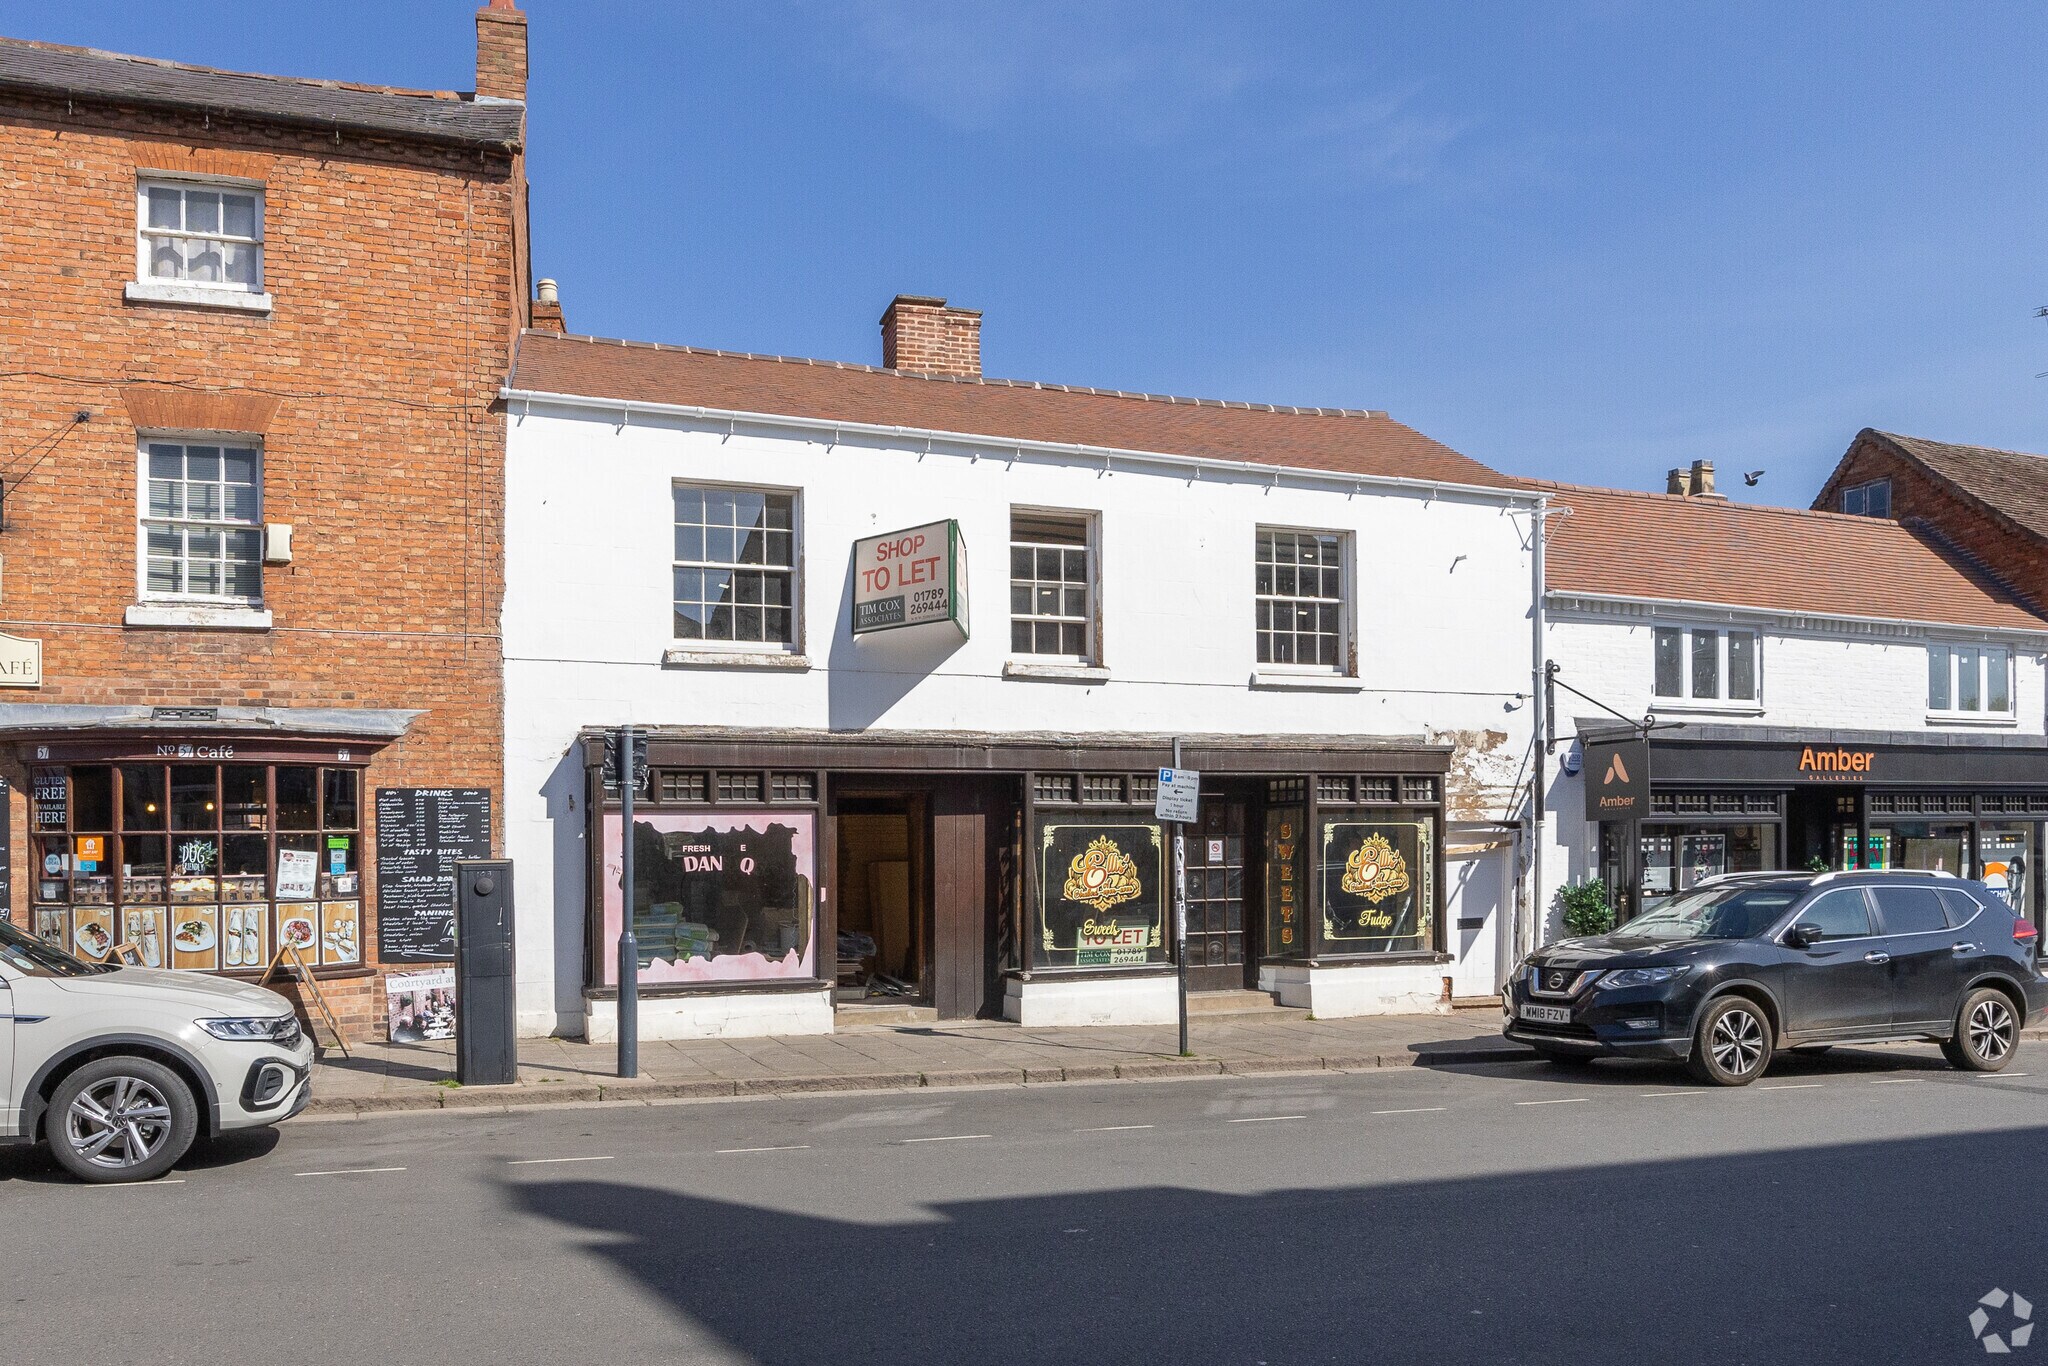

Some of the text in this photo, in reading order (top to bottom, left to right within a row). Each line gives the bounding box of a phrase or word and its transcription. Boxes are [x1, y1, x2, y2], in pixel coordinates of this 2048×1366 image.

[876, 535, 925, 561] SHOP
[862, 556, 940, 592] TO LET
[914, 588, 944, 602] 01789
[860, 600, 900, 615] TIM COX
[910, 599, 947, 614] 269444
[860, 612, 901, 624] ASSOCIATES
[197, 745, 234, 758] Café
[1800, 746, 1874, 771] Amber
[35, 787, 66, 799] FREE
[1600, 796, 1635, 807] Amber
[35, 812, 66, 823] HERE
[182, 845, 205, 864] DOG
[684, 856, 754, 875] DAN Q
[1278, 823, 1295, 944] SWEETS
[1359, 909, 1392, 929] Fudge
[1083, 919, 1120, 936] Sweets
[389, 976, 442, 989] Courtyard
[1526, 1007, 1565, 1020] WM18 FZV
